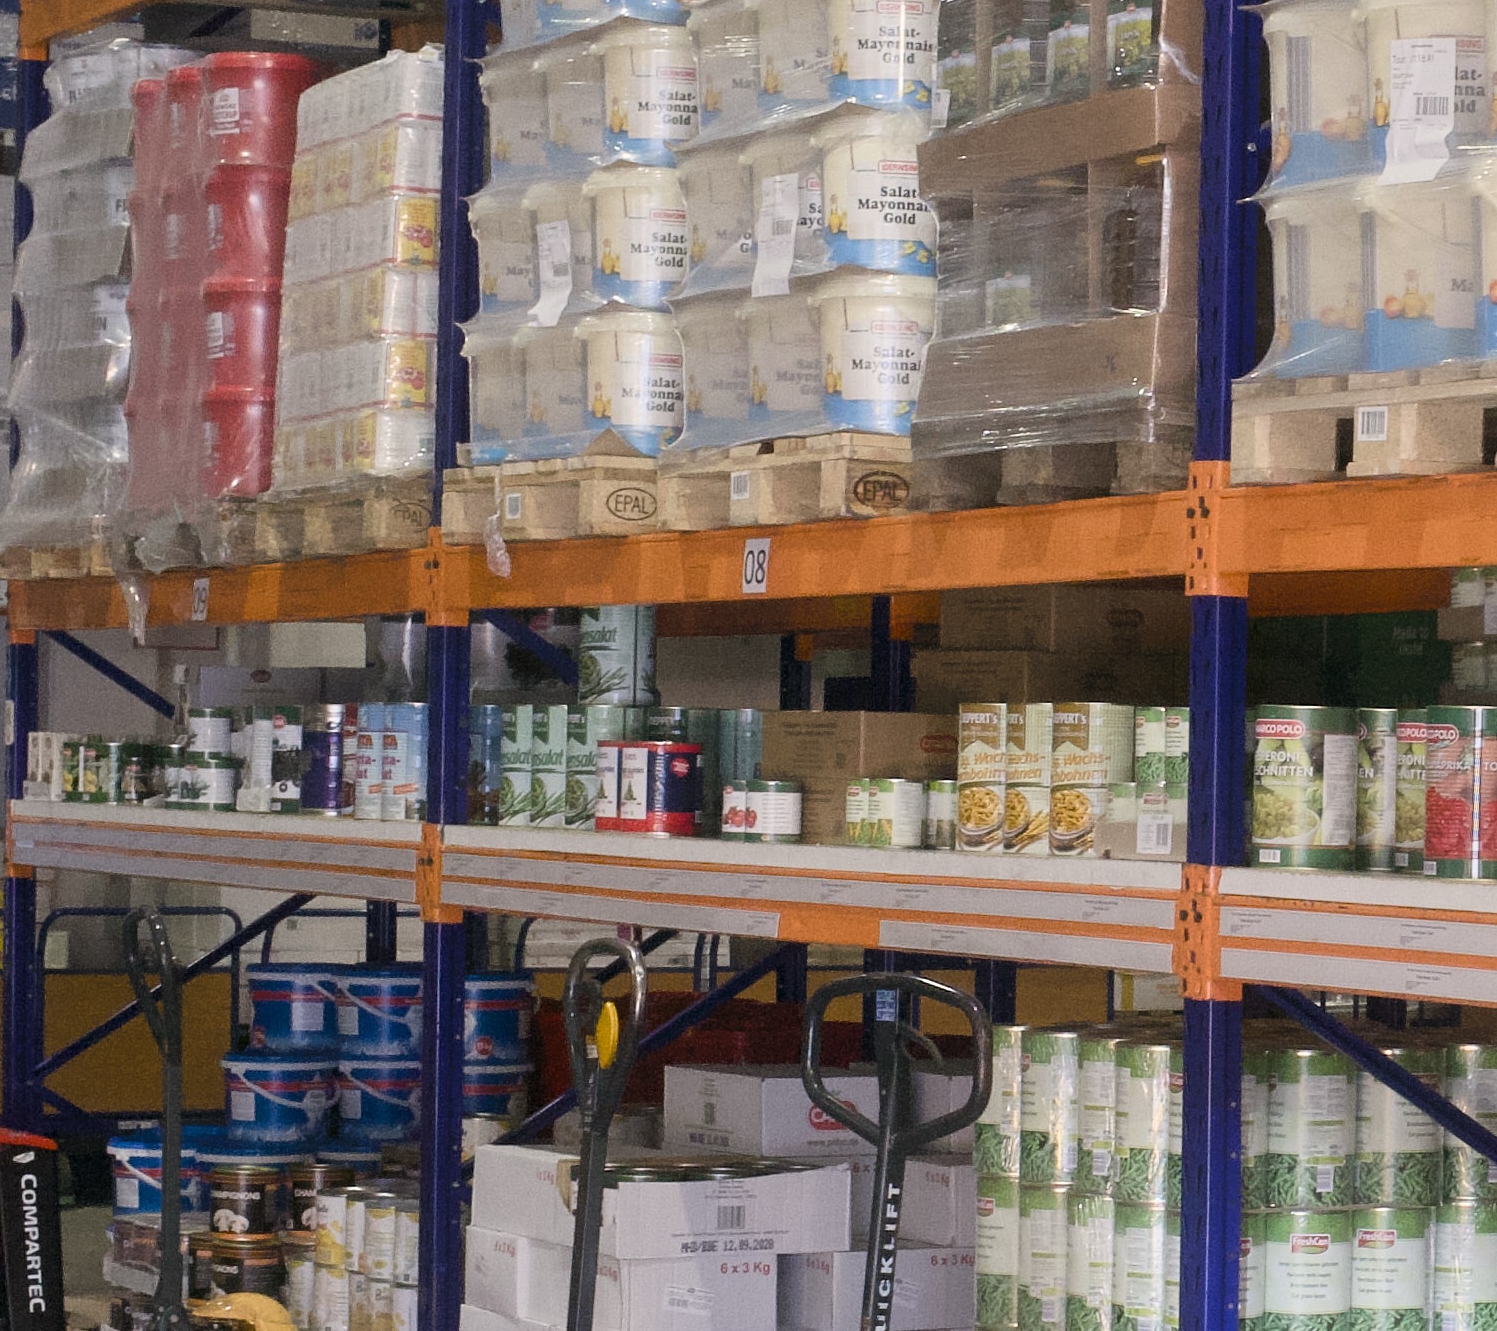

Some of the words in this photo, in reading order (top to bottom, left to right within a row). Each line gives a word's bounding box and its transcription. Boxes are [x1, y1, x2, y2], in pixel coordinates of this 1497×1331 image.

[614, 493, 649, 513] EPAL
[742, 548, 767, 585] 08
[19, 1173, 46, 1314] COMPARTEC
[720, 1263, 728, 1273] 6
[731, 1265, 739, 1273] x
[743, 1263, 751, 1273] 3
[753, 1261, 771, 1275] Kg
